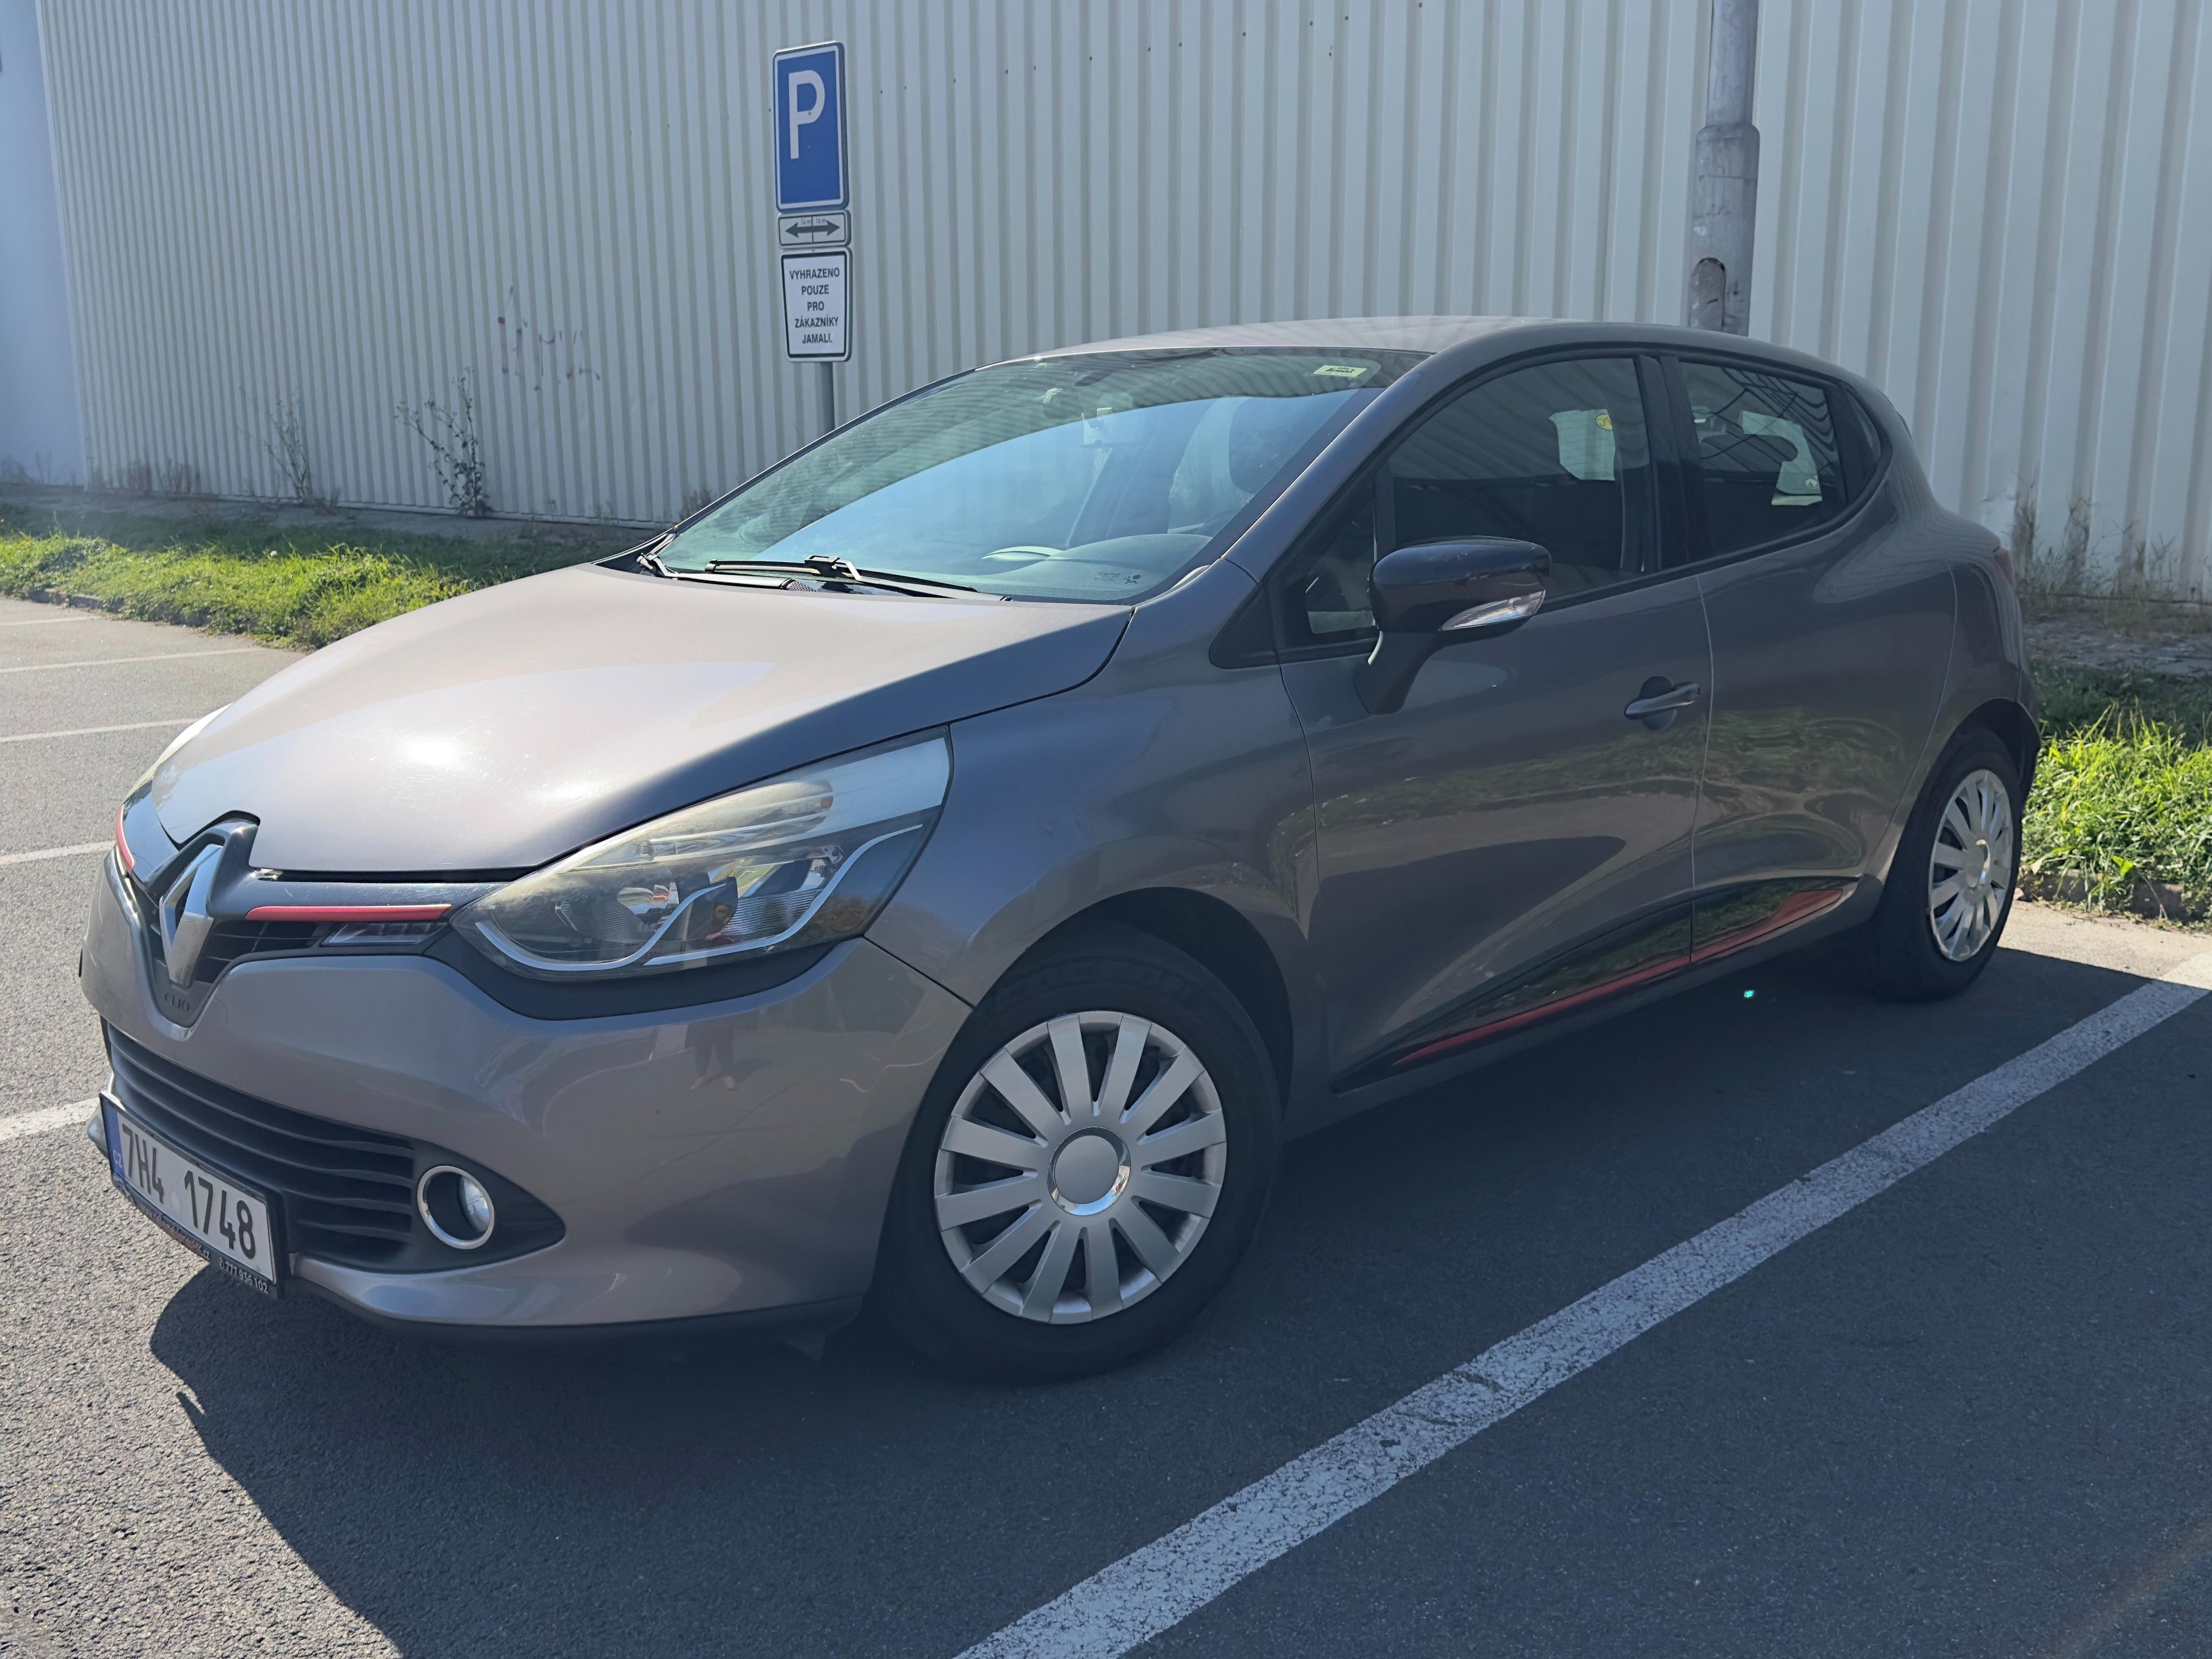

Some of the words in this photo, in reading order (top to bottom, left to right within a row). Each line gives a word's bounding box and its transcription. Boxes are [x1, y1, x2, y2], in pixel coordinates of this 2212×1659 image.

[788, 70, 825, 159] P
[790, 267, 840, 280] VYHRAZENO
[801, 285, 829, 295] POUZE
[807, 301, 824, 311] PRO
[795, 314, 838, 328] ZÁKAZNÍKY
[113, 1150, 123, 1168] CZ
[122, 1123, 164, 1204] 7H4
[184, 1170, 255, 1259] 1748
[254, 1278, 268, 1294] 102
